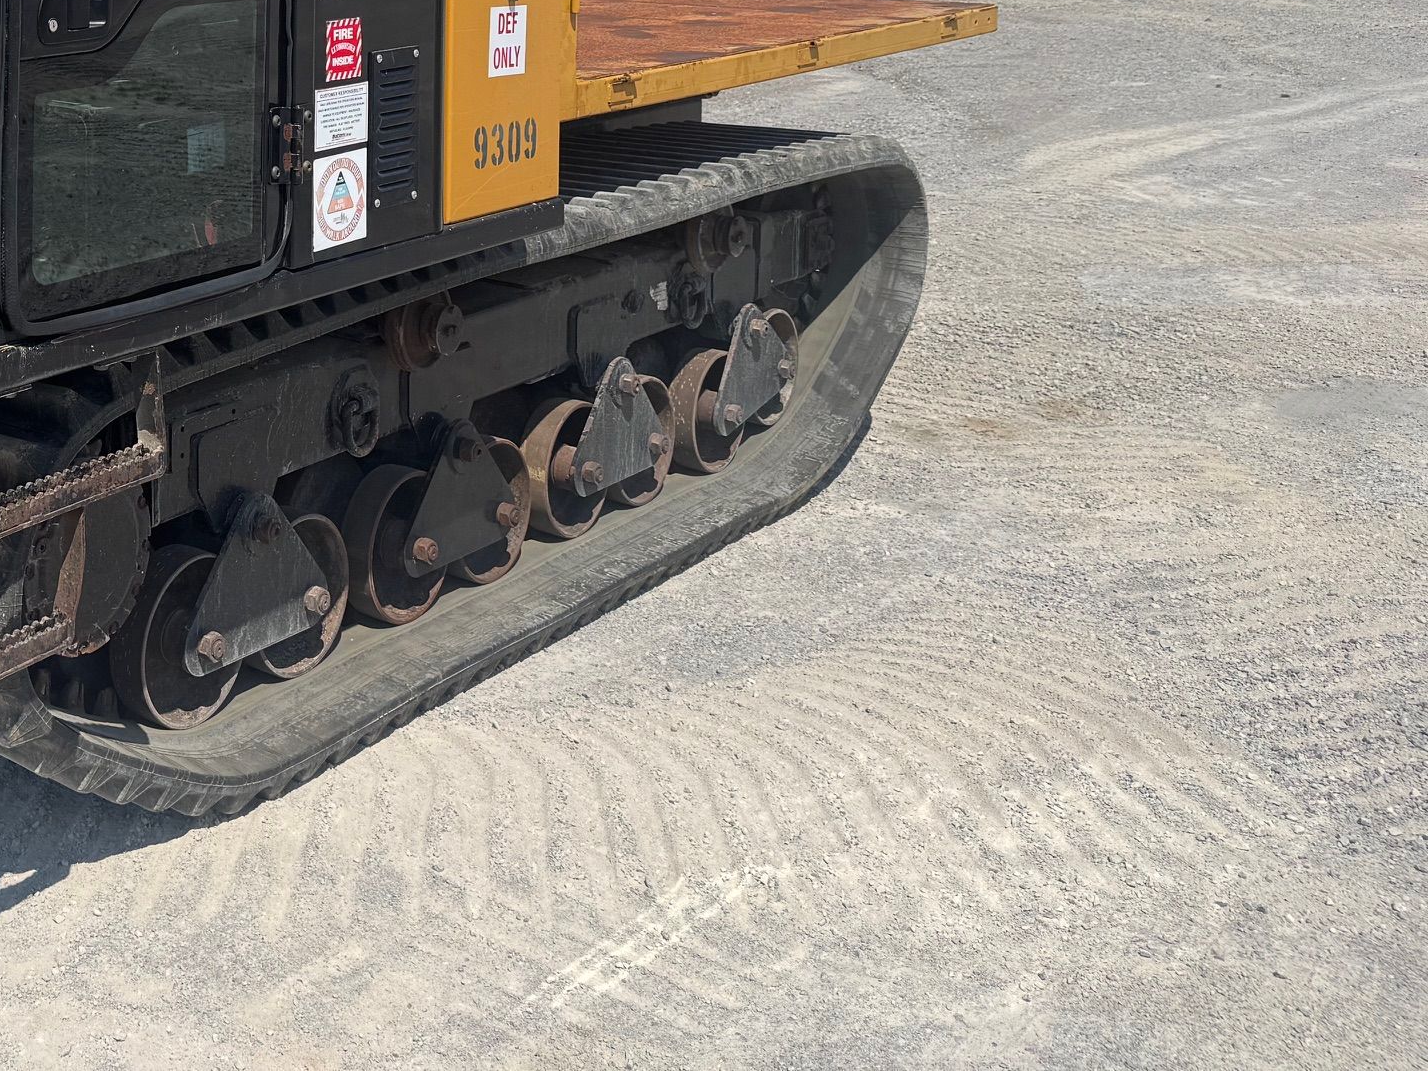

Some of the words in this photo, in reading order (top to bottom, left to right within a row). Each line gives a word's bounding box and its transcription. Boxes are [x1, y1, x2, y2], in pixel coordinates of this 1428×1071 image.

[333, 28, 353, 41] FIRE
[497, 12, 519, 35] DEF
[332, 55, 354, 67] INSIDE
[493, 46, 521, 70] ONLY
[474, 117, 538, 170] 9309
